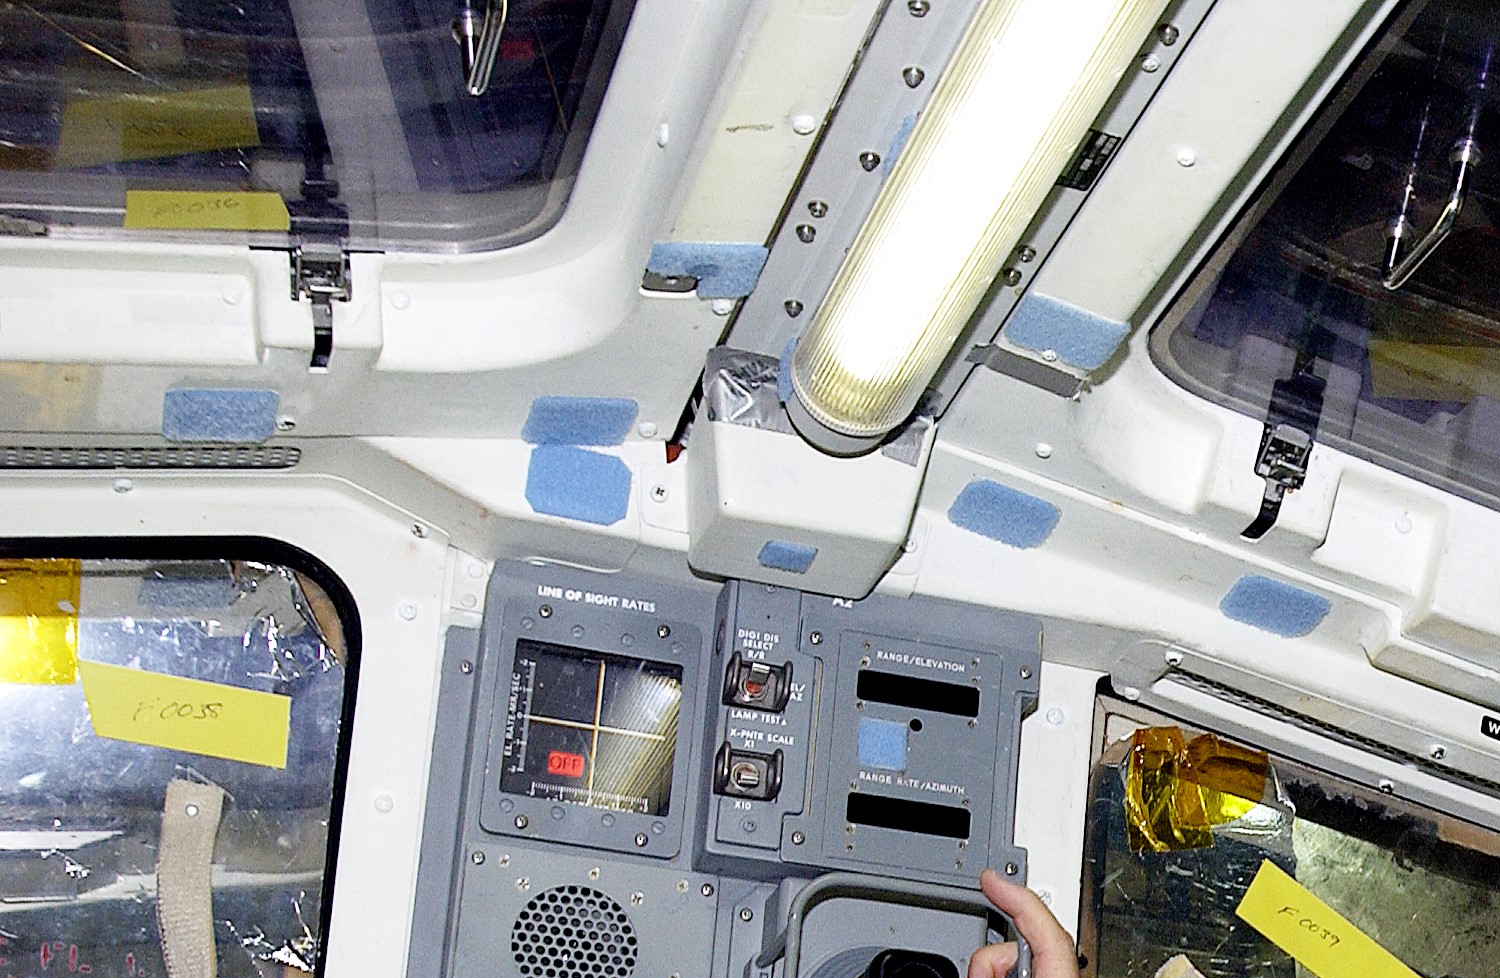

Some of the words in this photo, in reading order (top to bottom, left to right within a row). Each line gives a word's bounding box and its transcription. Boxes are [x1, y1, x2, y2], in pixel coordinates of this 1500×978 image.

[537, 585, 563, 600] LINE
[565, 587, 583, 602] OF
[585, 591, 620, 608] SIGHT
[622, 597, 656, 613] RATES
[742, 639, 774, 651] SELECT
[763, 632, 780, 644] DIS
[747, 650, 766, 660] R/R
[876, 650, 967, 674] RANGE/ELEVATION
[731, 710, 759, 721] LAMP
[761, 713, 781, 726] TEST
[767, 732, 796, 746] SCALE
[549, 754, 580, 771] OFF
[859, 771, 893, 786] RANGE
[735, 800, 752, 810] X10
